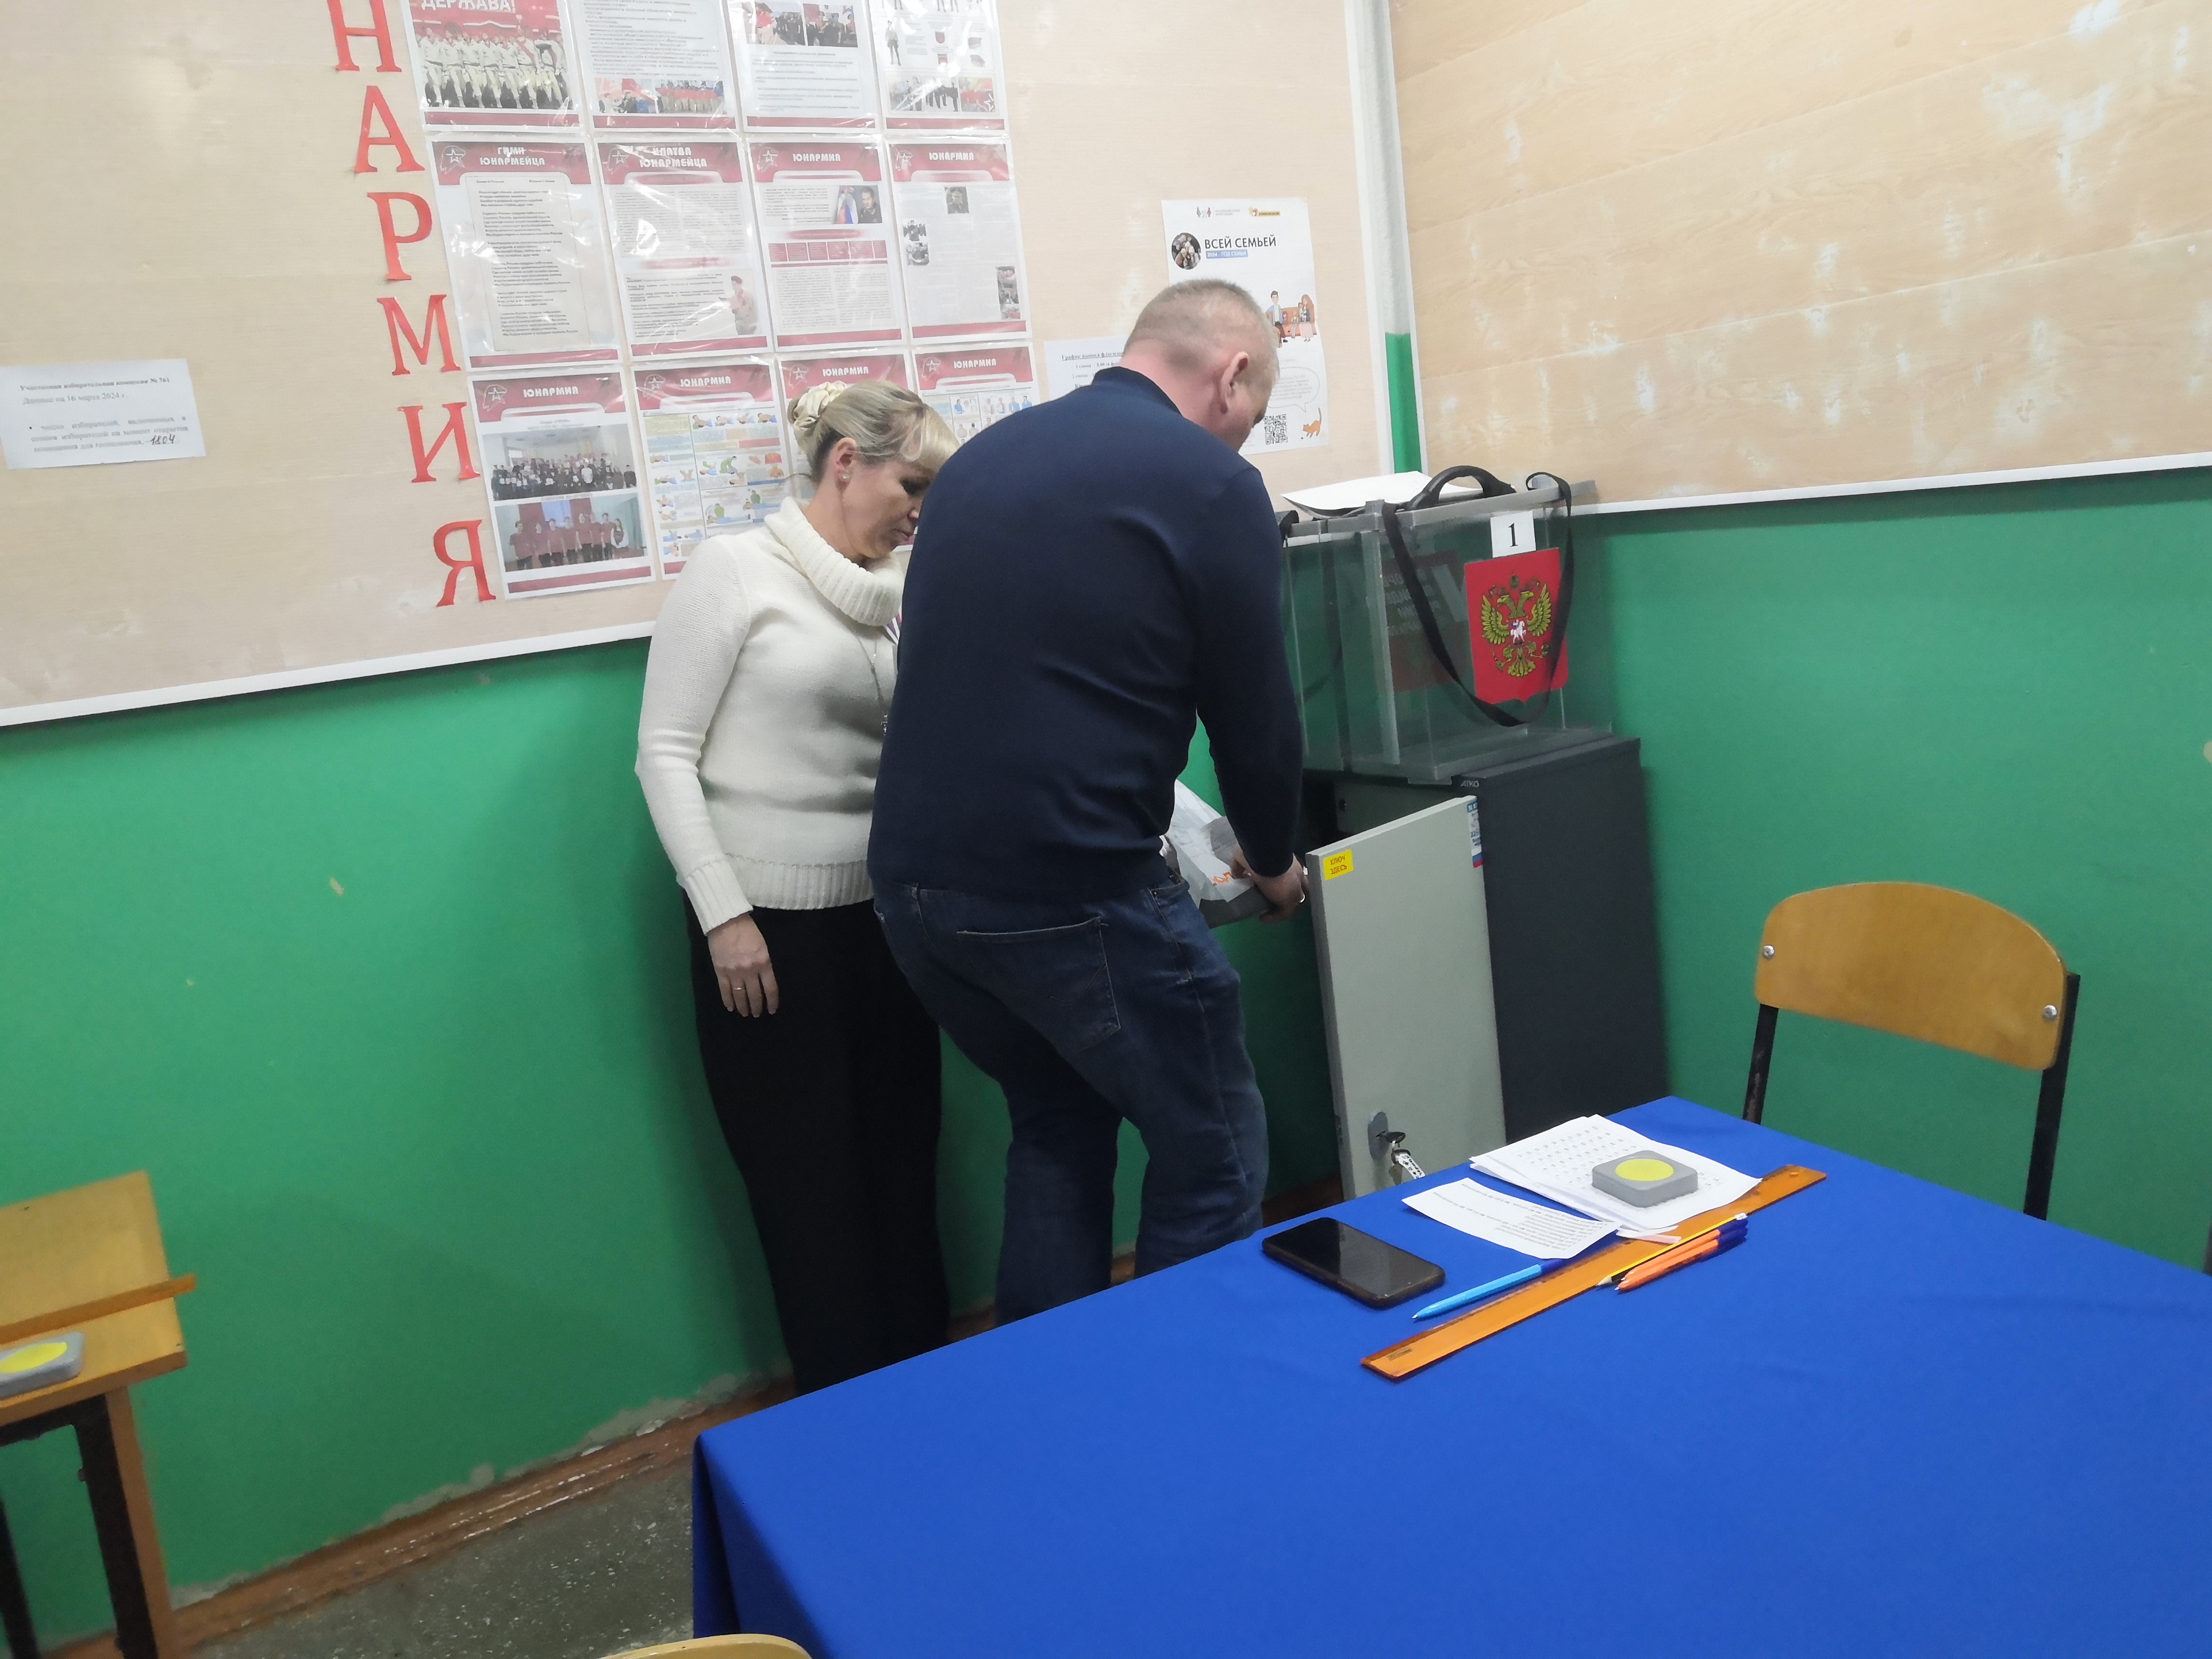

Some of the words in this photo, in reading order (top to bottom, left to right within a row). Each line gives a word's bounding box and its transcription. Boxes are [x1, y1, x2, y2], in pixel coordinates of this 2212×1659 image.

[497, 147, 526, 155] ГИМН
[929, 152, 974, 160] ЮНАРМИЯ
[480, 156, 545, 167] ЮНАРМЕЙЦА
[639, 157, 707, 168] ЮНАРМЕЙЦА
[793, 153, 841, 162] ЮНАРМИЯ
[1204, 236, 1232, 249] ВСЕЙ
[1235, 234, 1276, 248] СЕМЬЕЙ
[953, 358, 997, 369] ЮНАРМИЯ
[822, 366, 868, 377] ЮНАРМИЯ
[680, 376, 731, 387] ЮНАРМИЯ
[523, 386, 578, 397] ЮНАРМИЯ
[1508, 522, 1519, 548] 1
[1330, 854, 1346, 866] КЛЮЧ
[1330, 865, 1347, 875] ЗДЕСЬ
